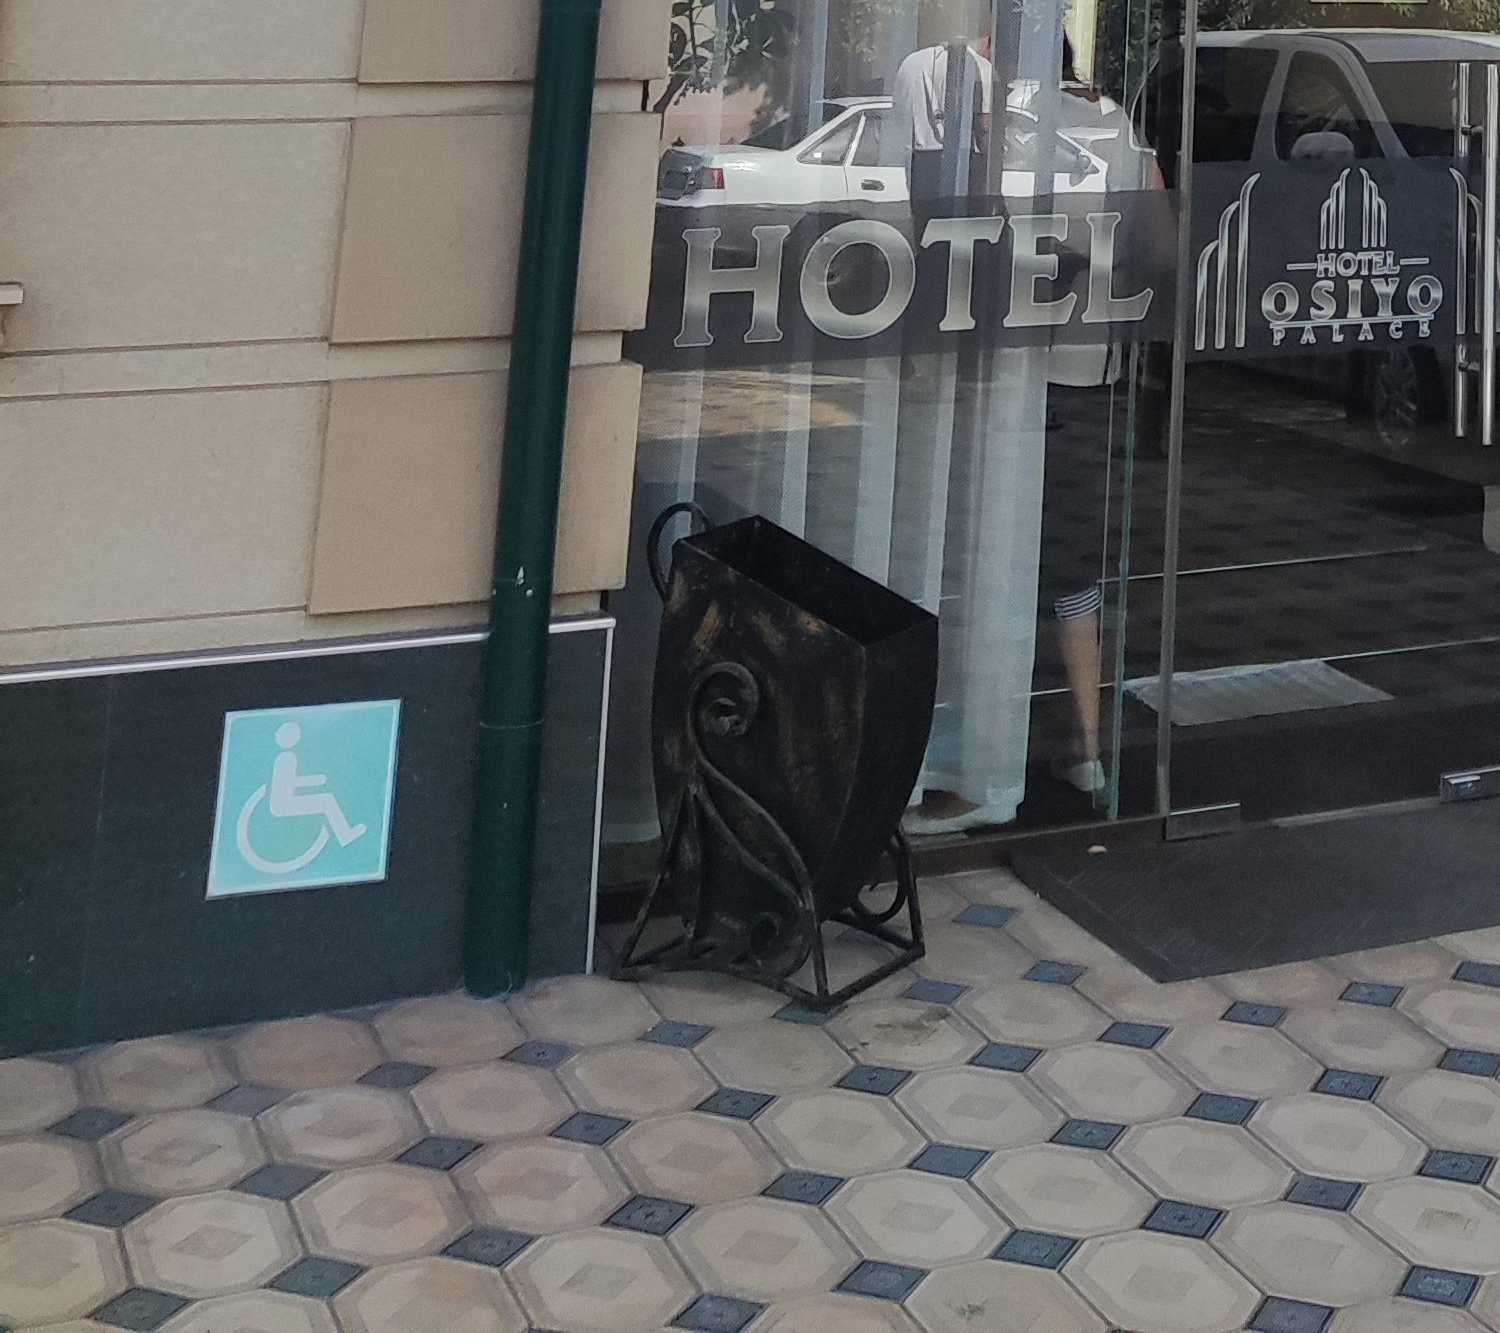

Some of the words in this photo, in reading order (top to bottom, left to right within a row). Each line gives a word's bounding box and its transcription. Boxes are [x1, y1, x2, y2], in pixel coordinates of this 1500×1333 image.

[673, 211, 1154, 349] HOTEL
[1316, 250, 1400, 278] HOTEL
[1261, 275, 1443, 323] OSIYO
[1272, 319, 1431, 346] PALACE
